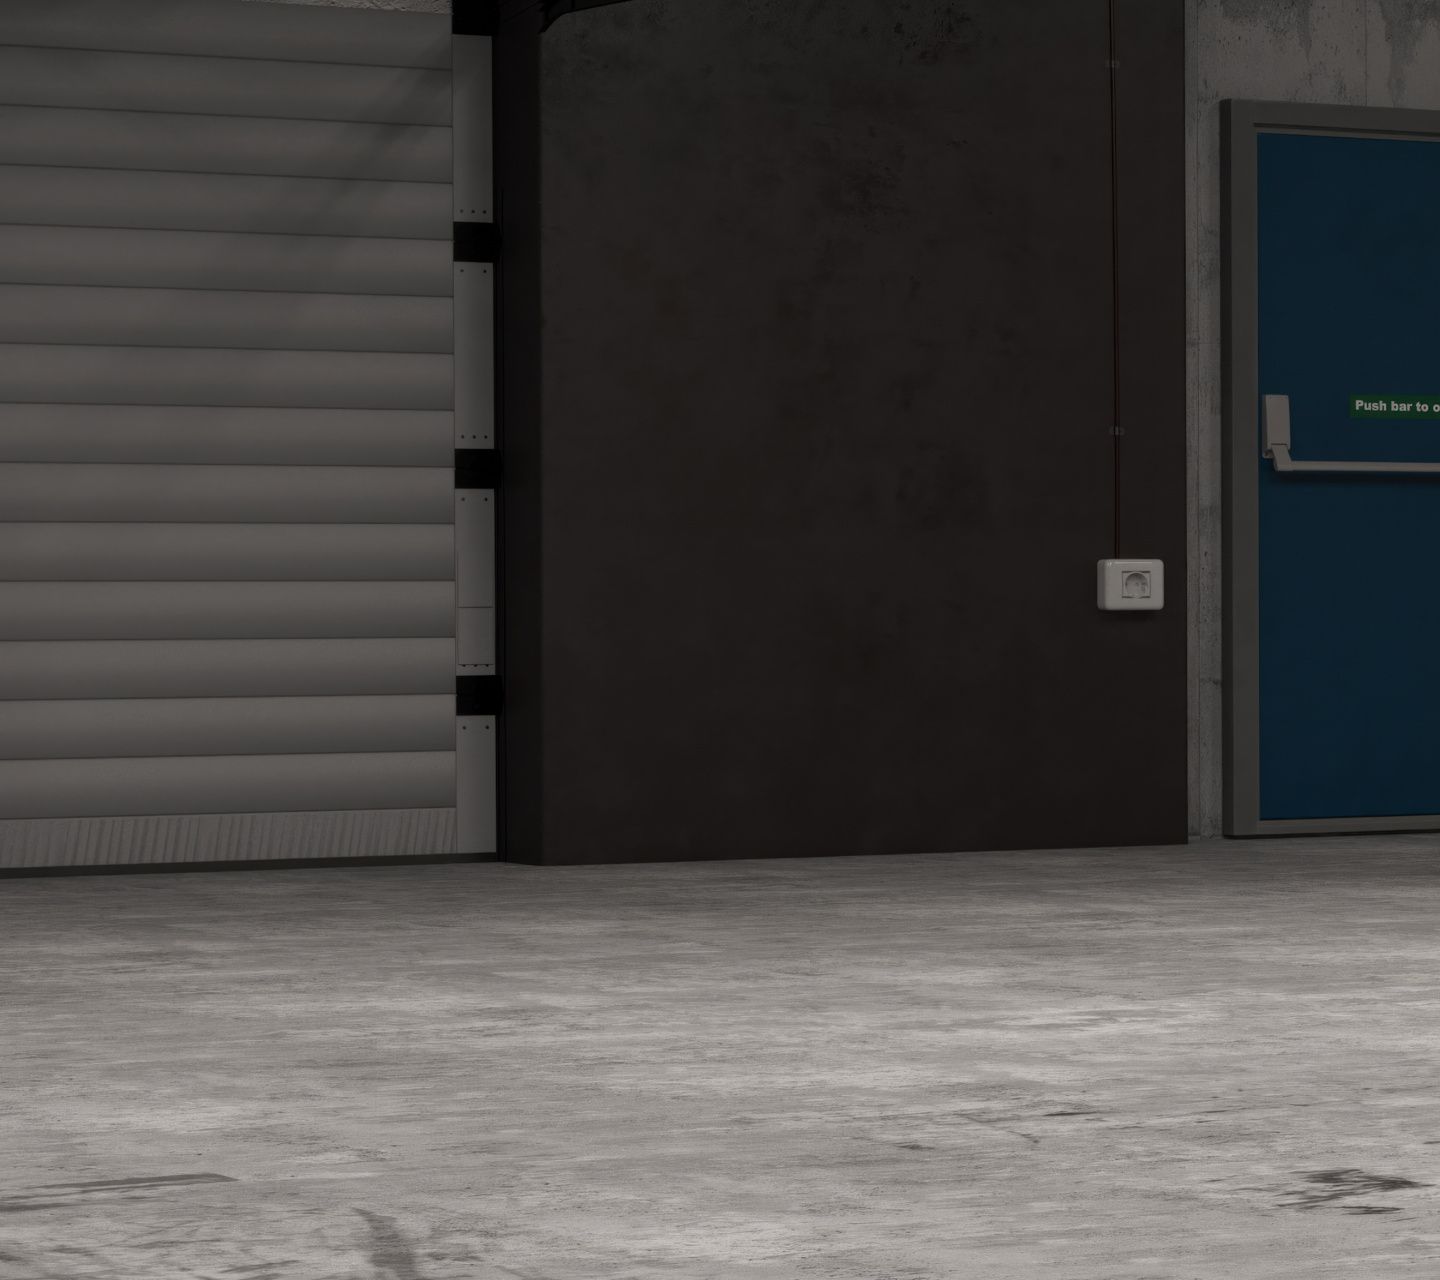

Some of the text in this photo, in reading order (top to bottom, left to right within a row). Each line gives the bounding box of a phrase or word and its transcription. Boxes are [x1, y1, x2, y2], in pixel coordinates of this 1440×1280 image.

[1355, 400, 1387, 411] Push
[1391, 401, 1412, 412] bar
[1416, 401, 1429, 413] to
